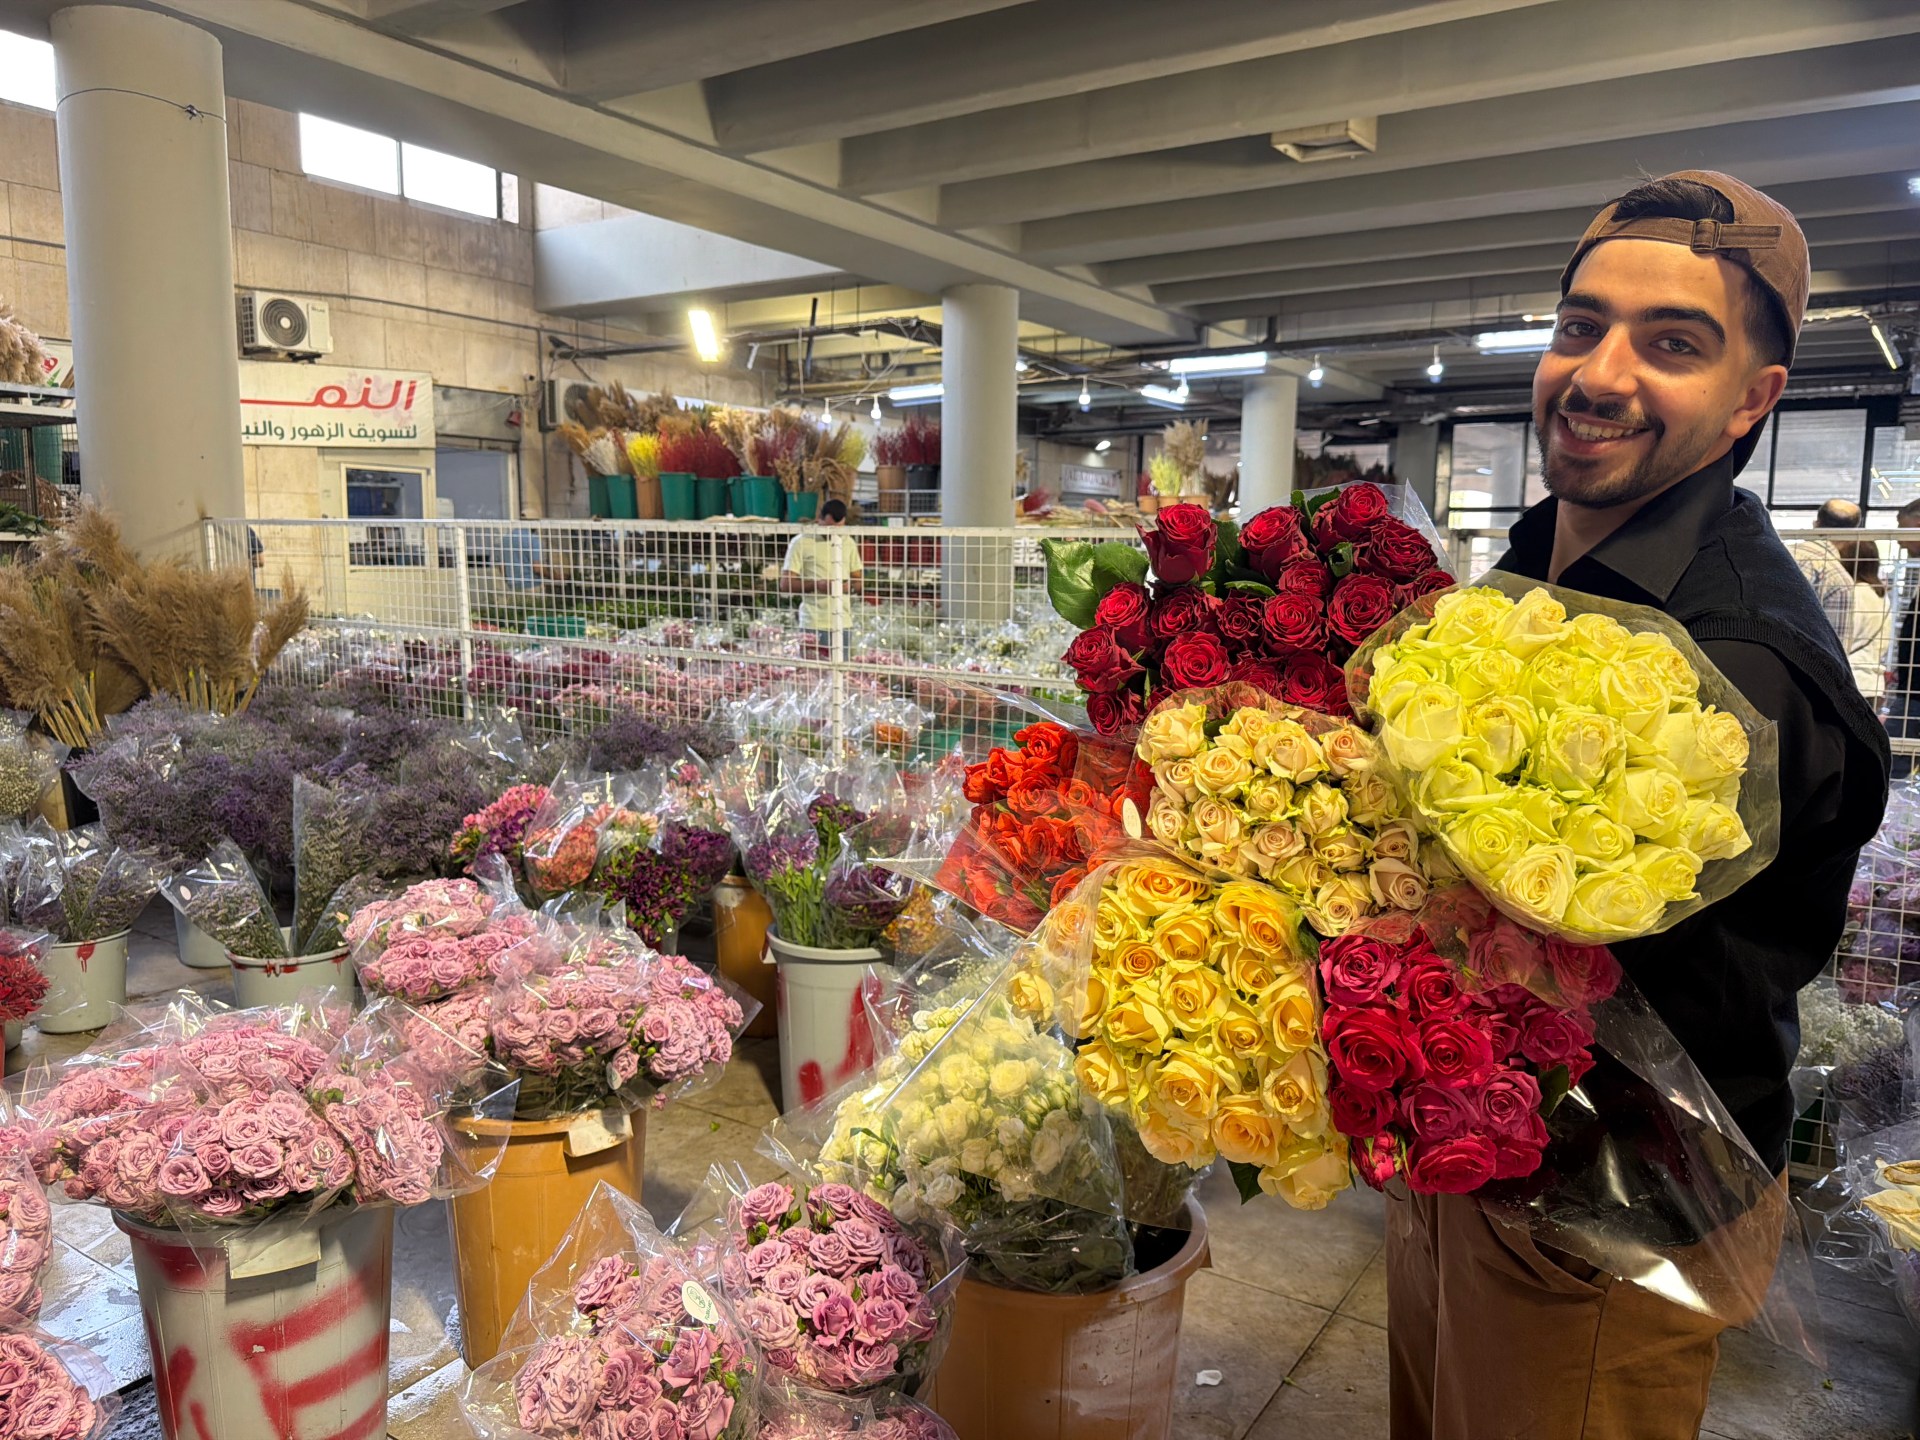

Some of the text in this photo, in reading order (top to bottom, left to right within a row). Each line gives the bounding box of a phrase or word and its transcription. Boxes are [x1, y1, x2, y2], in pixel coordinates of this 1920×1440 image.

[240, 377, 417, 410] النم
[241, 420, 417, 442] لتسويق الزهور والنب
